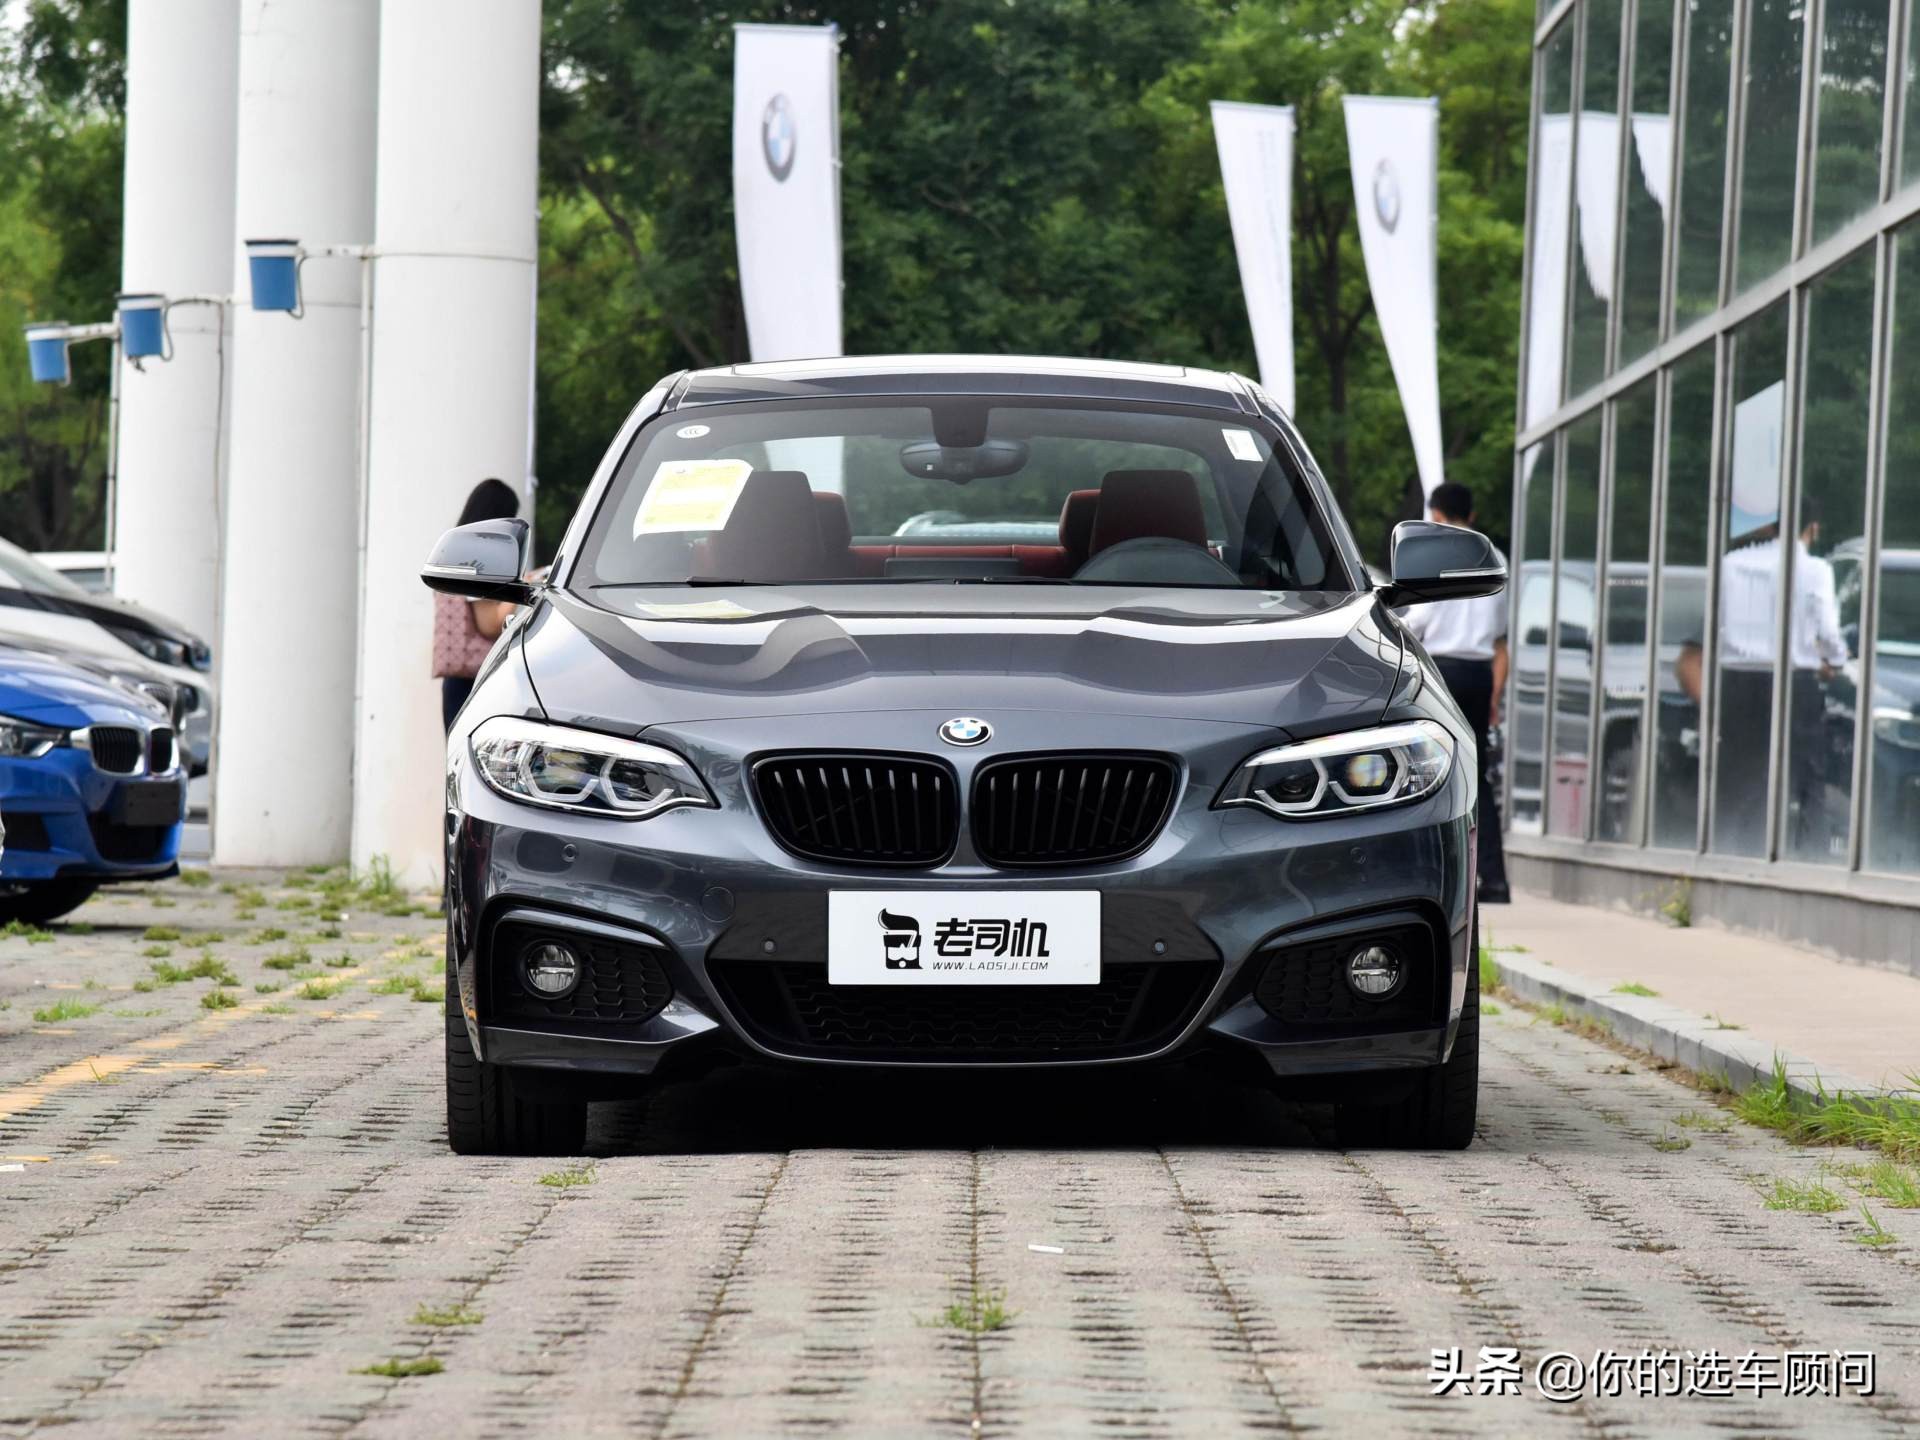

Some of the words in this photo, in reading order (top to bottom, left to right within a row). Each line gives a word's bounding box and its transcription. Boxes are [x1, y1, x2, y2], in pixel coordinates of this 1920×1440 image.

[933, 917, 1050, 957] 老司机
[932, 961, 1049, 971] WWW.LAOSIJI.COM
